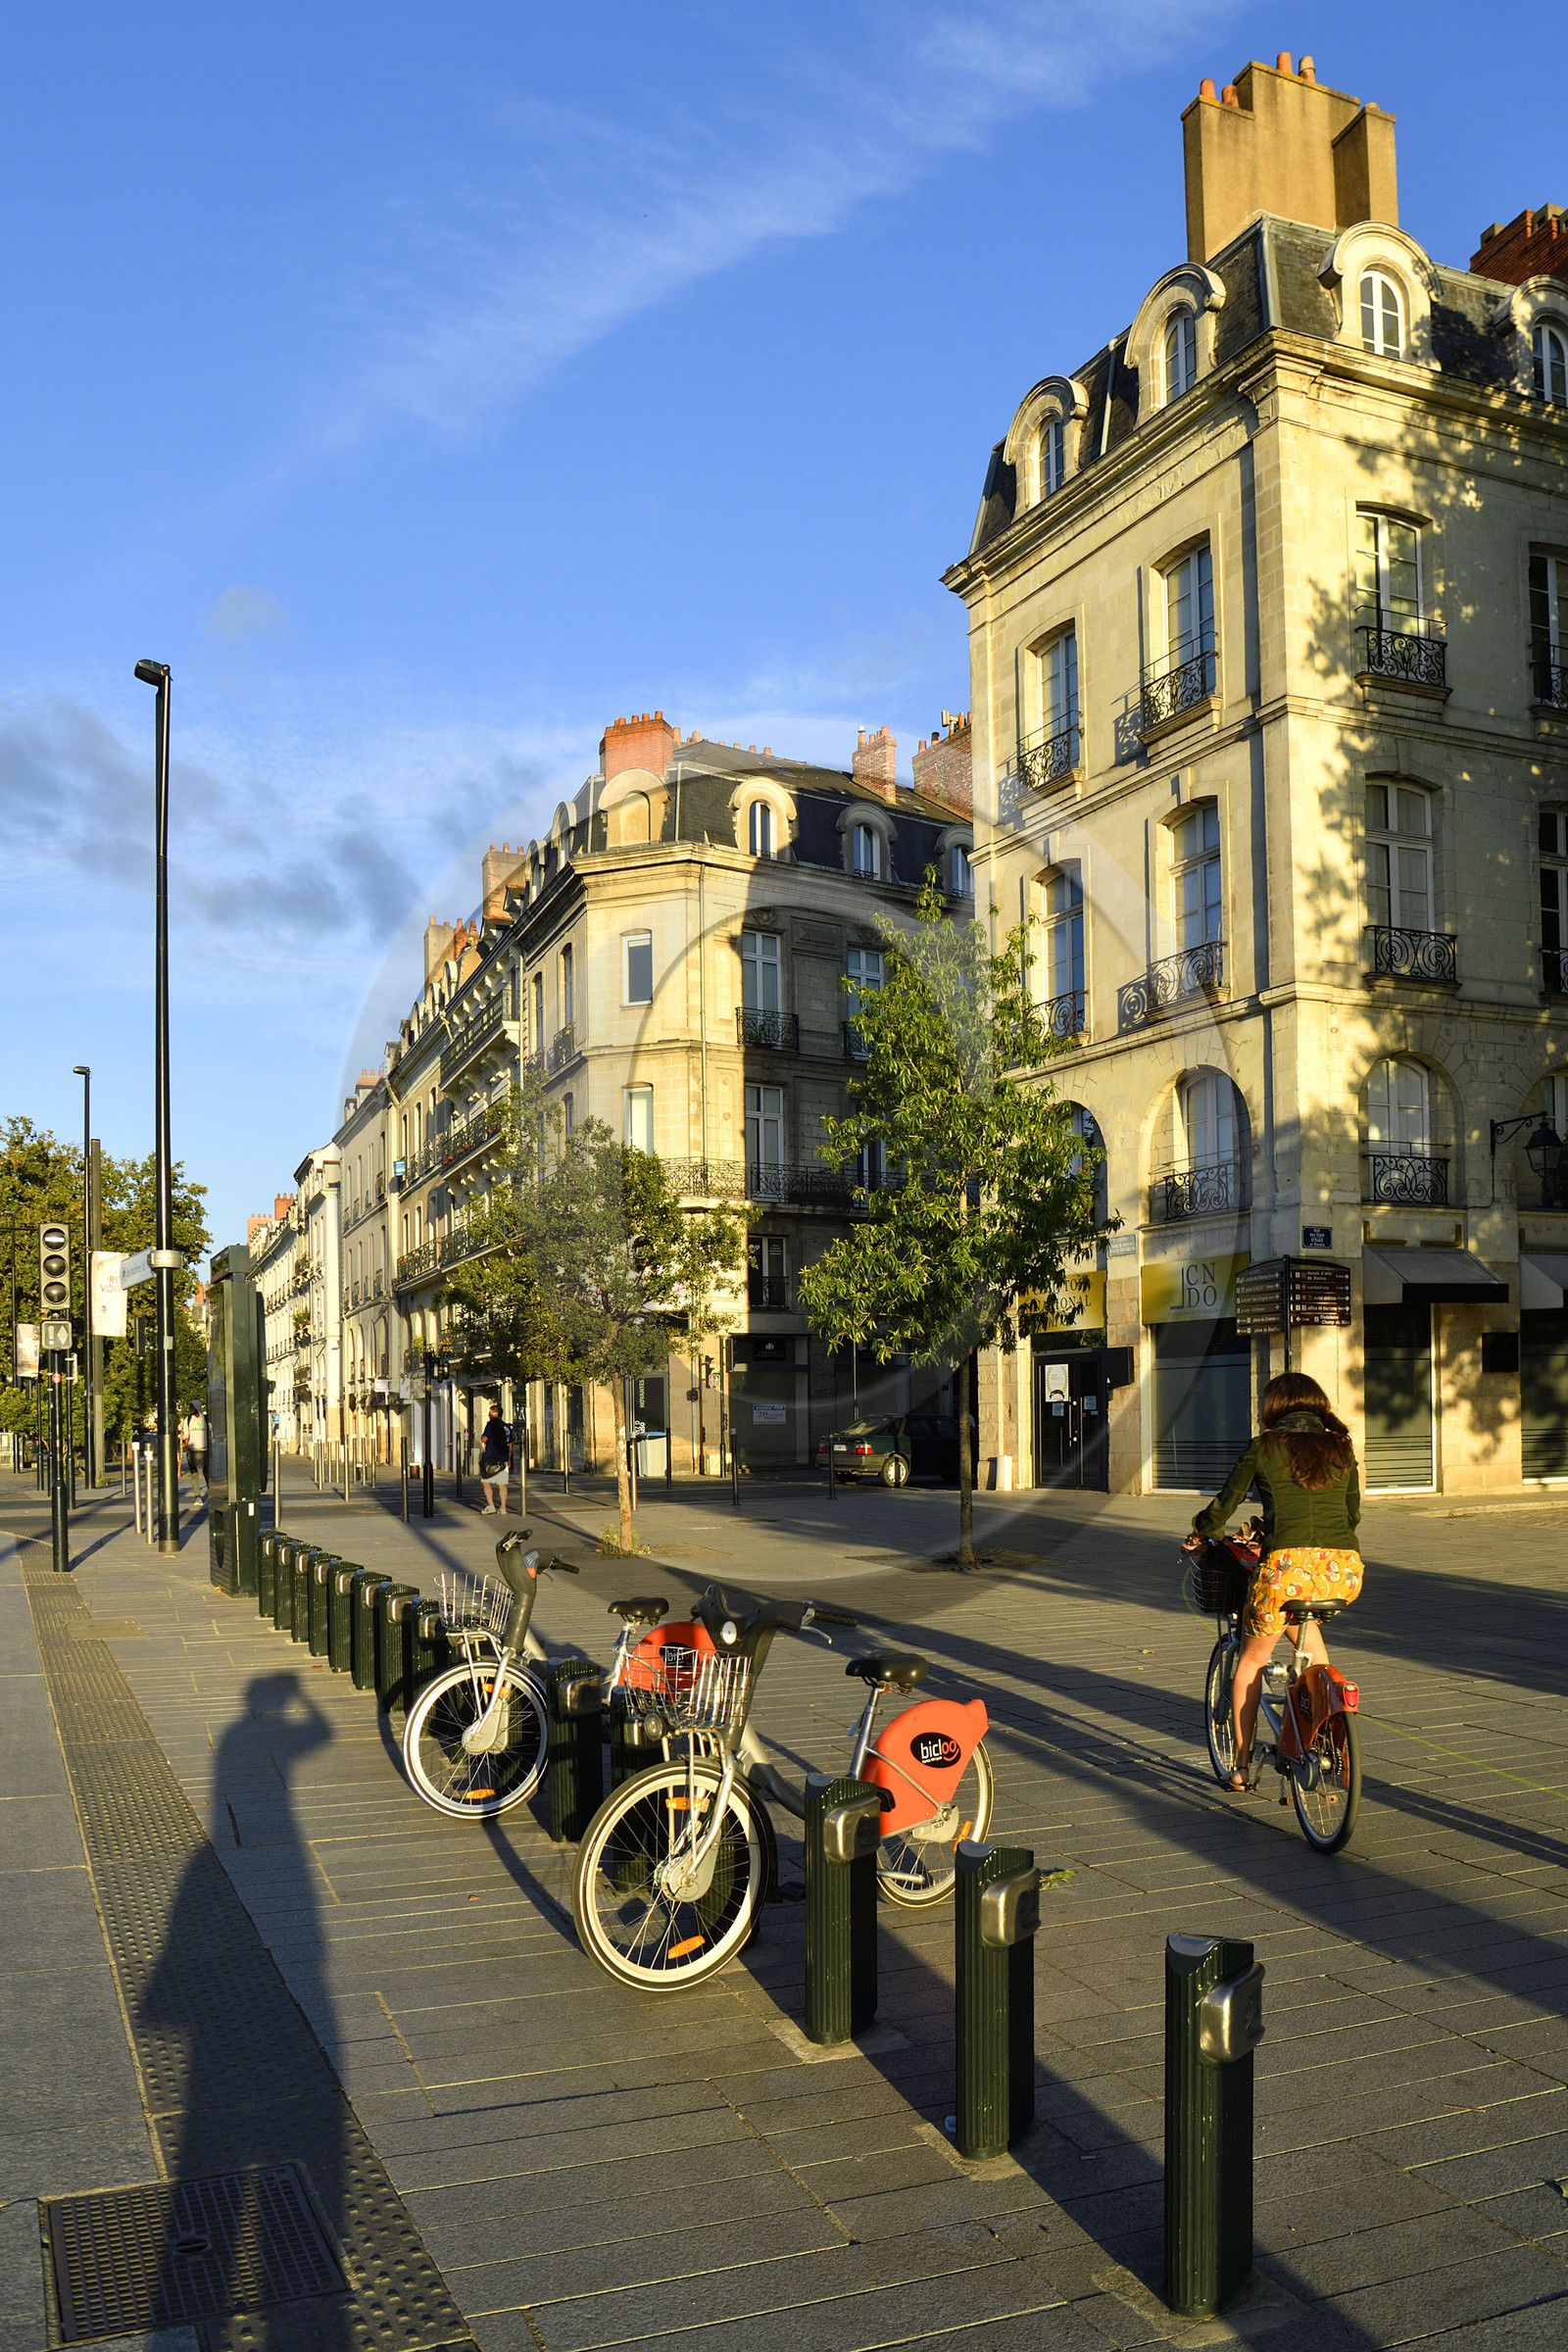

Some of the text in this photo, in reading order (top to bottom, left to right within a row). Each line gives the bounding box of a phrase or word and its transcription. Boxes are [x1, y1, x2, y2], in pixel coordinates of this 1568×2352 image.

[1186, 1262, 1217, 1286] CN
[1187, 1285, 1217, 1308] DO
[920, 1739, 957, 1760] bicloo
